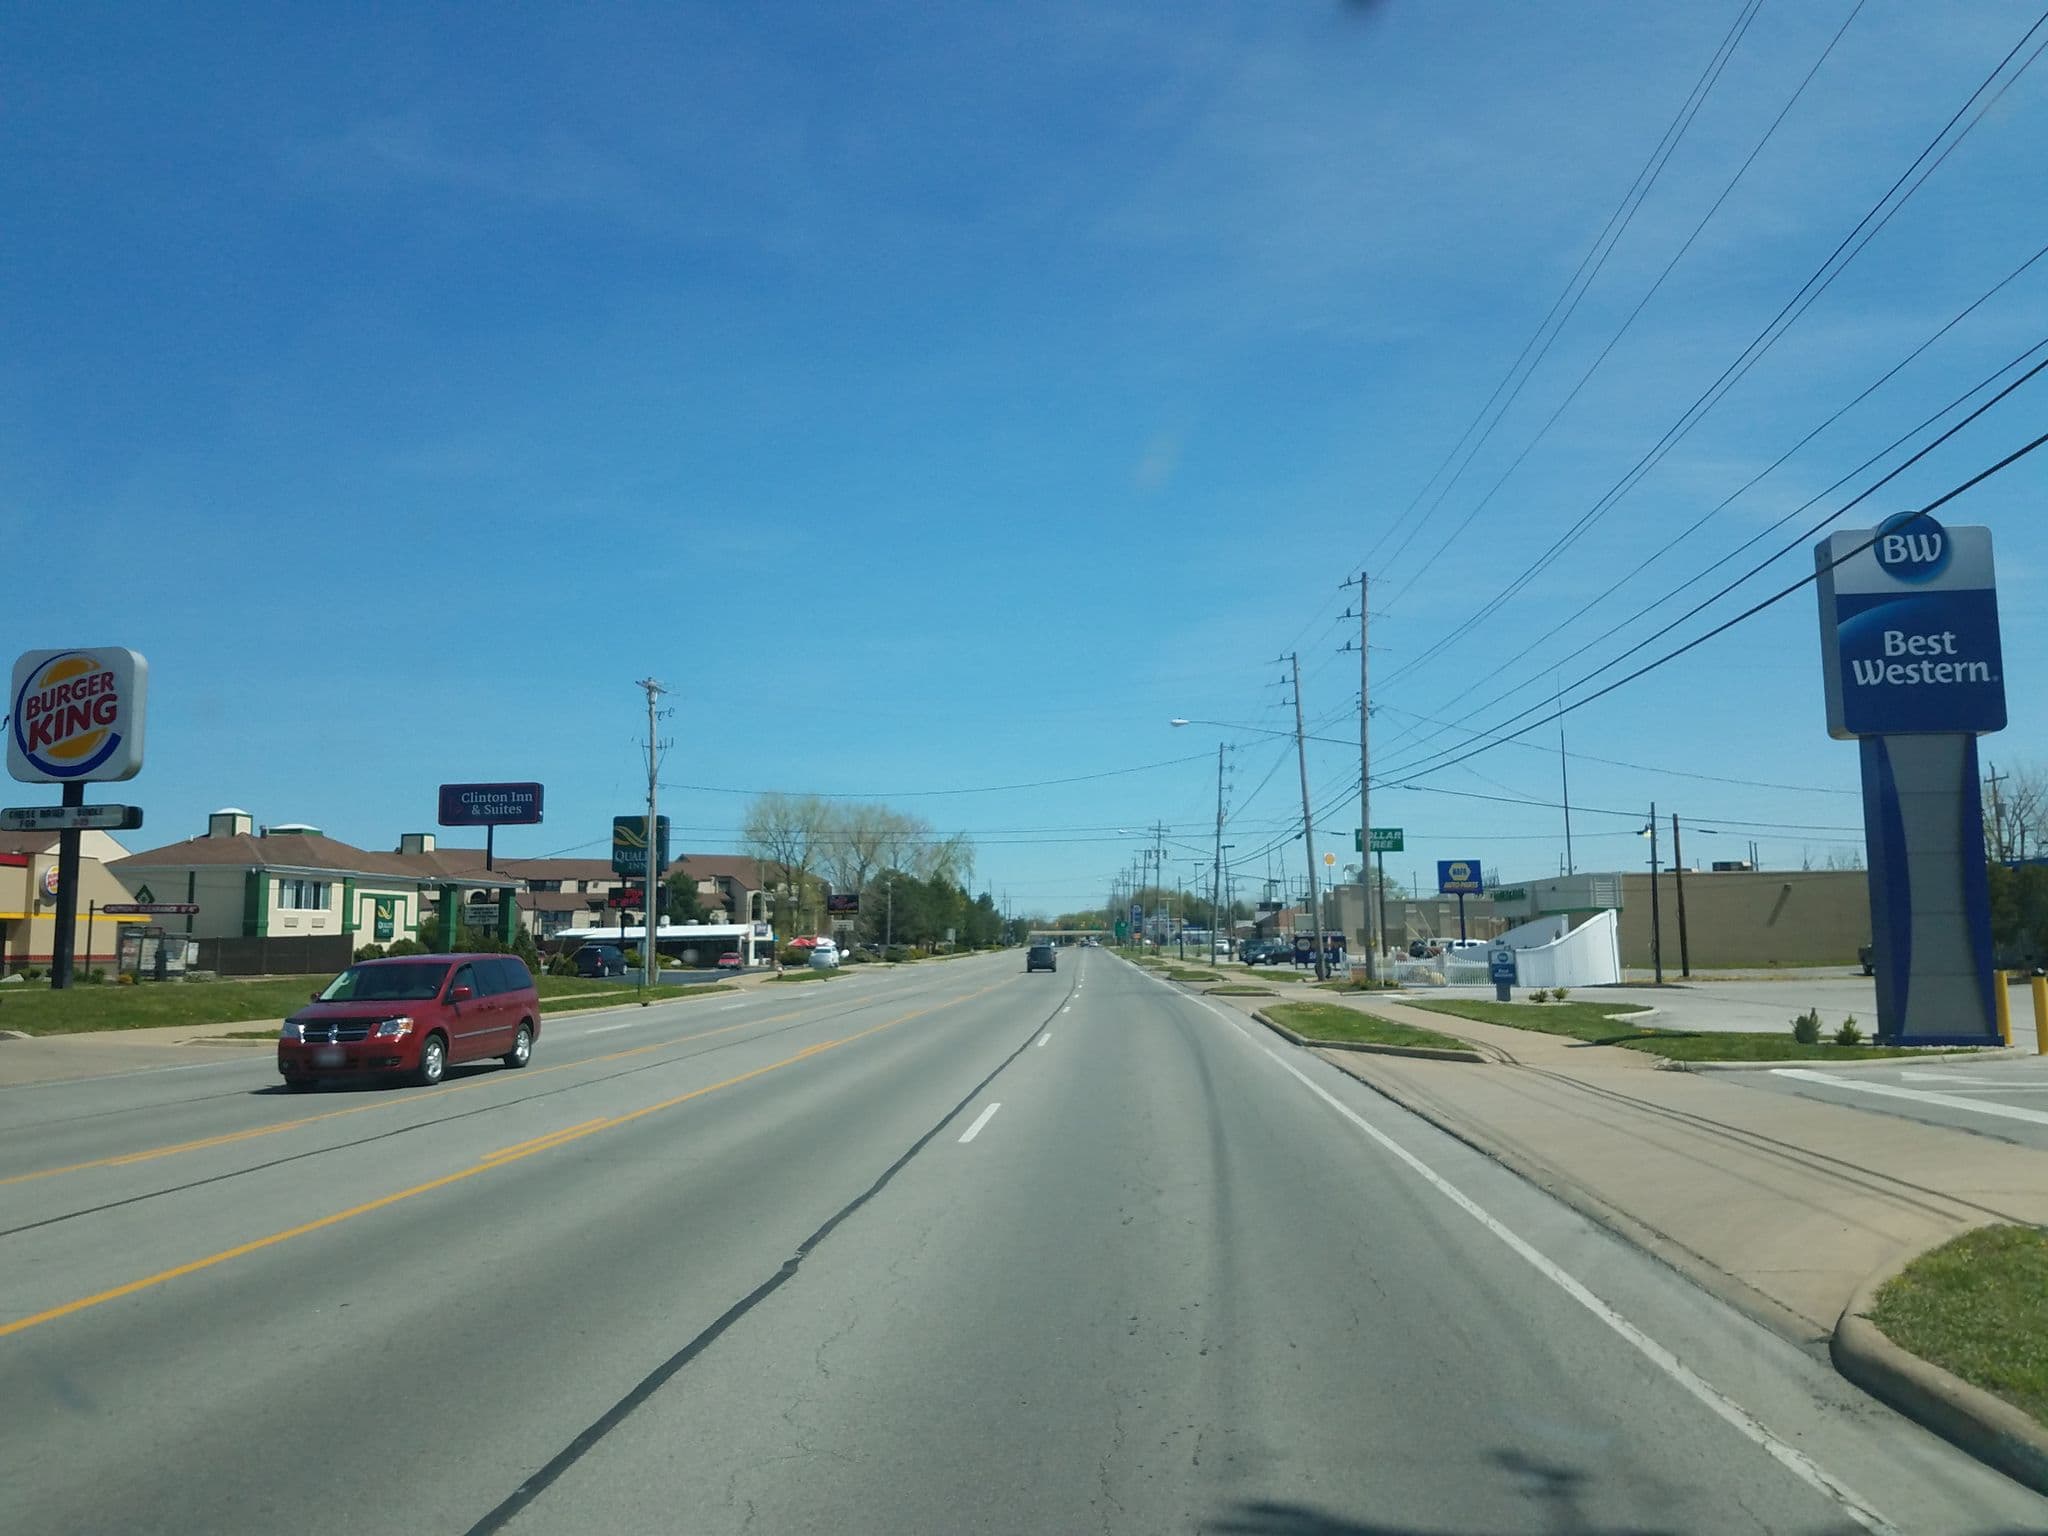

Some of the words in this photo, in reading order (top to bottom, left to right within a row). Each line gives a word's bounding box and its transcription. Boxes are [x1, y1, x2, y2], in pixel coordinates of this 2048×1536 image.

[1882, 532, 1943, 564] BW
[1883, 630, 1958, 657] Best
[1852, 659, 1990, 686] Western
[26, 671, 114, 721] BURGER
[28, 693, 118, 753] KING
[461, 791, 508, 803] Clinton
[511, 791, 533, 802] Inn
[471, 804, 481, 815] &
[484, 803, 522, 815] Suites
